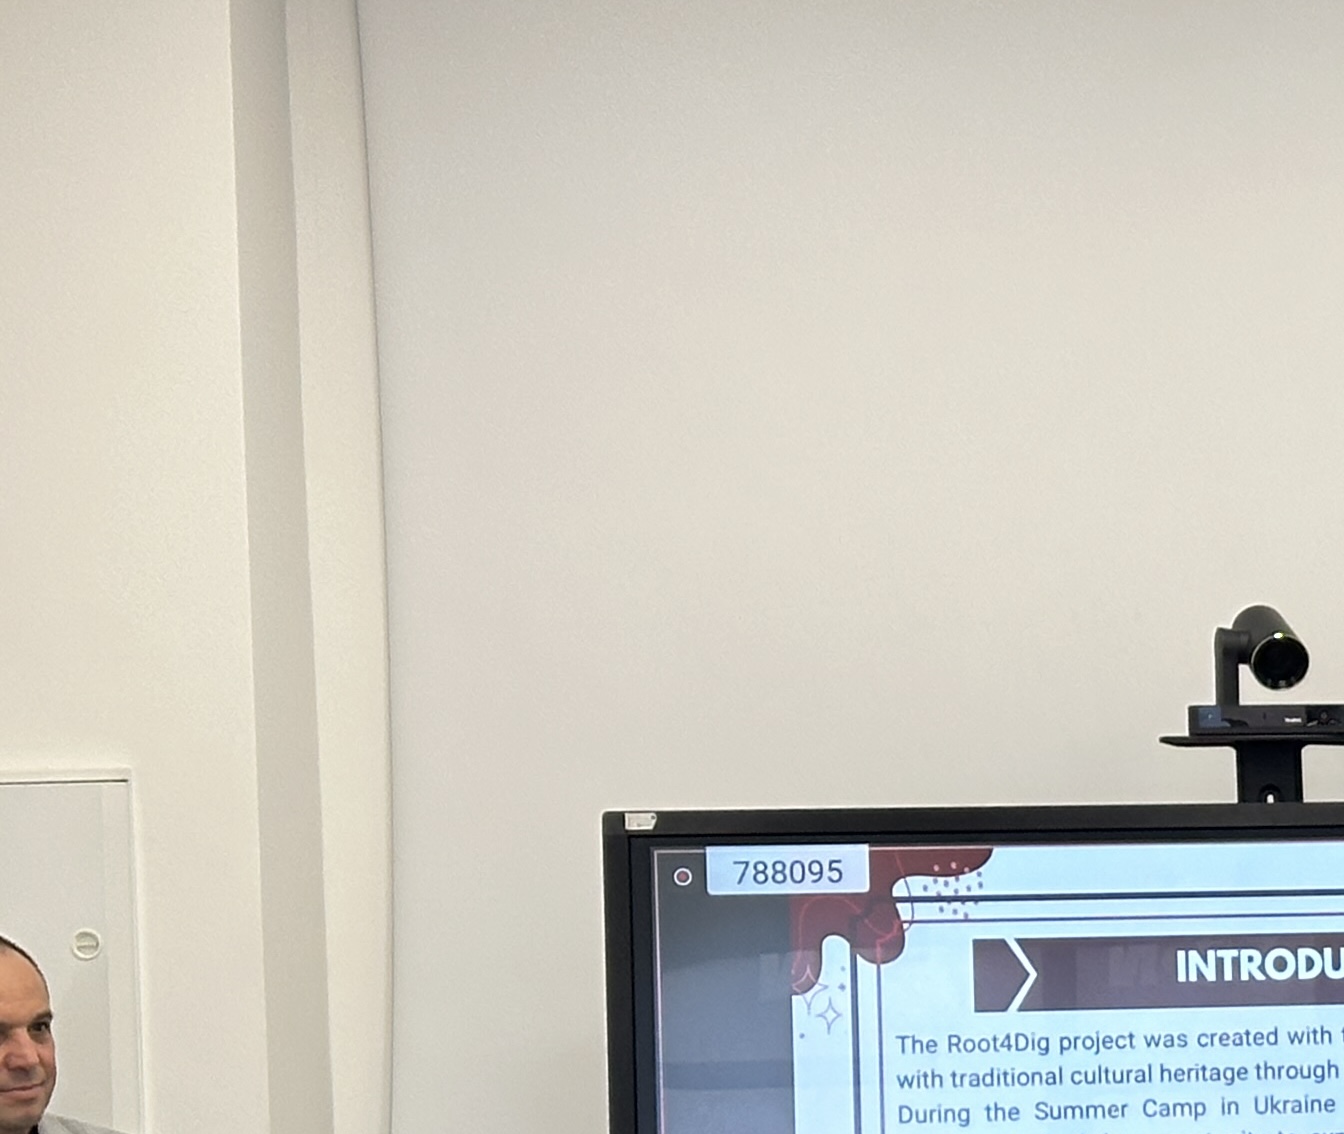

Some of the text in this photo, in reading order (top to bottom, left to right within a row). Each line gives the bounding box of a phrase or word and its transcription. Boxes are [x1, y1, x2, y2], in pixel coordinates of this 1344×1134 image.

[732, 860, 844, 885] 788095
[895, 1035, 938, 1054] The
[948, 1032, 1049, 1056] Root4Dig
[1060, 1031, 1135, 1056] project
[1144, 1031, 1188, 1048] was
[1197, 1026, 1278, 1048] created
[1287, 1025, 1332, 1045] with
[897, 1069, 943, 1089] with
[950, 1066, 1063, 1088] traditional
[1071, 1063, 1152, 1085] cultural
[1160, 1063, 1248, 1086] heritage
[1254, 1059, 1339, 1084] through
[899, 1104, 970, 1127] During
[984, 1102, 1020, 1122] the
[1035, 1101, 1128, 1120] Summer
[1143, 1099, 1206, 1121] Camp
[1221, 1097, 1239, 1116] in
[1254, 1094, 1335, 1115] Ukraine
